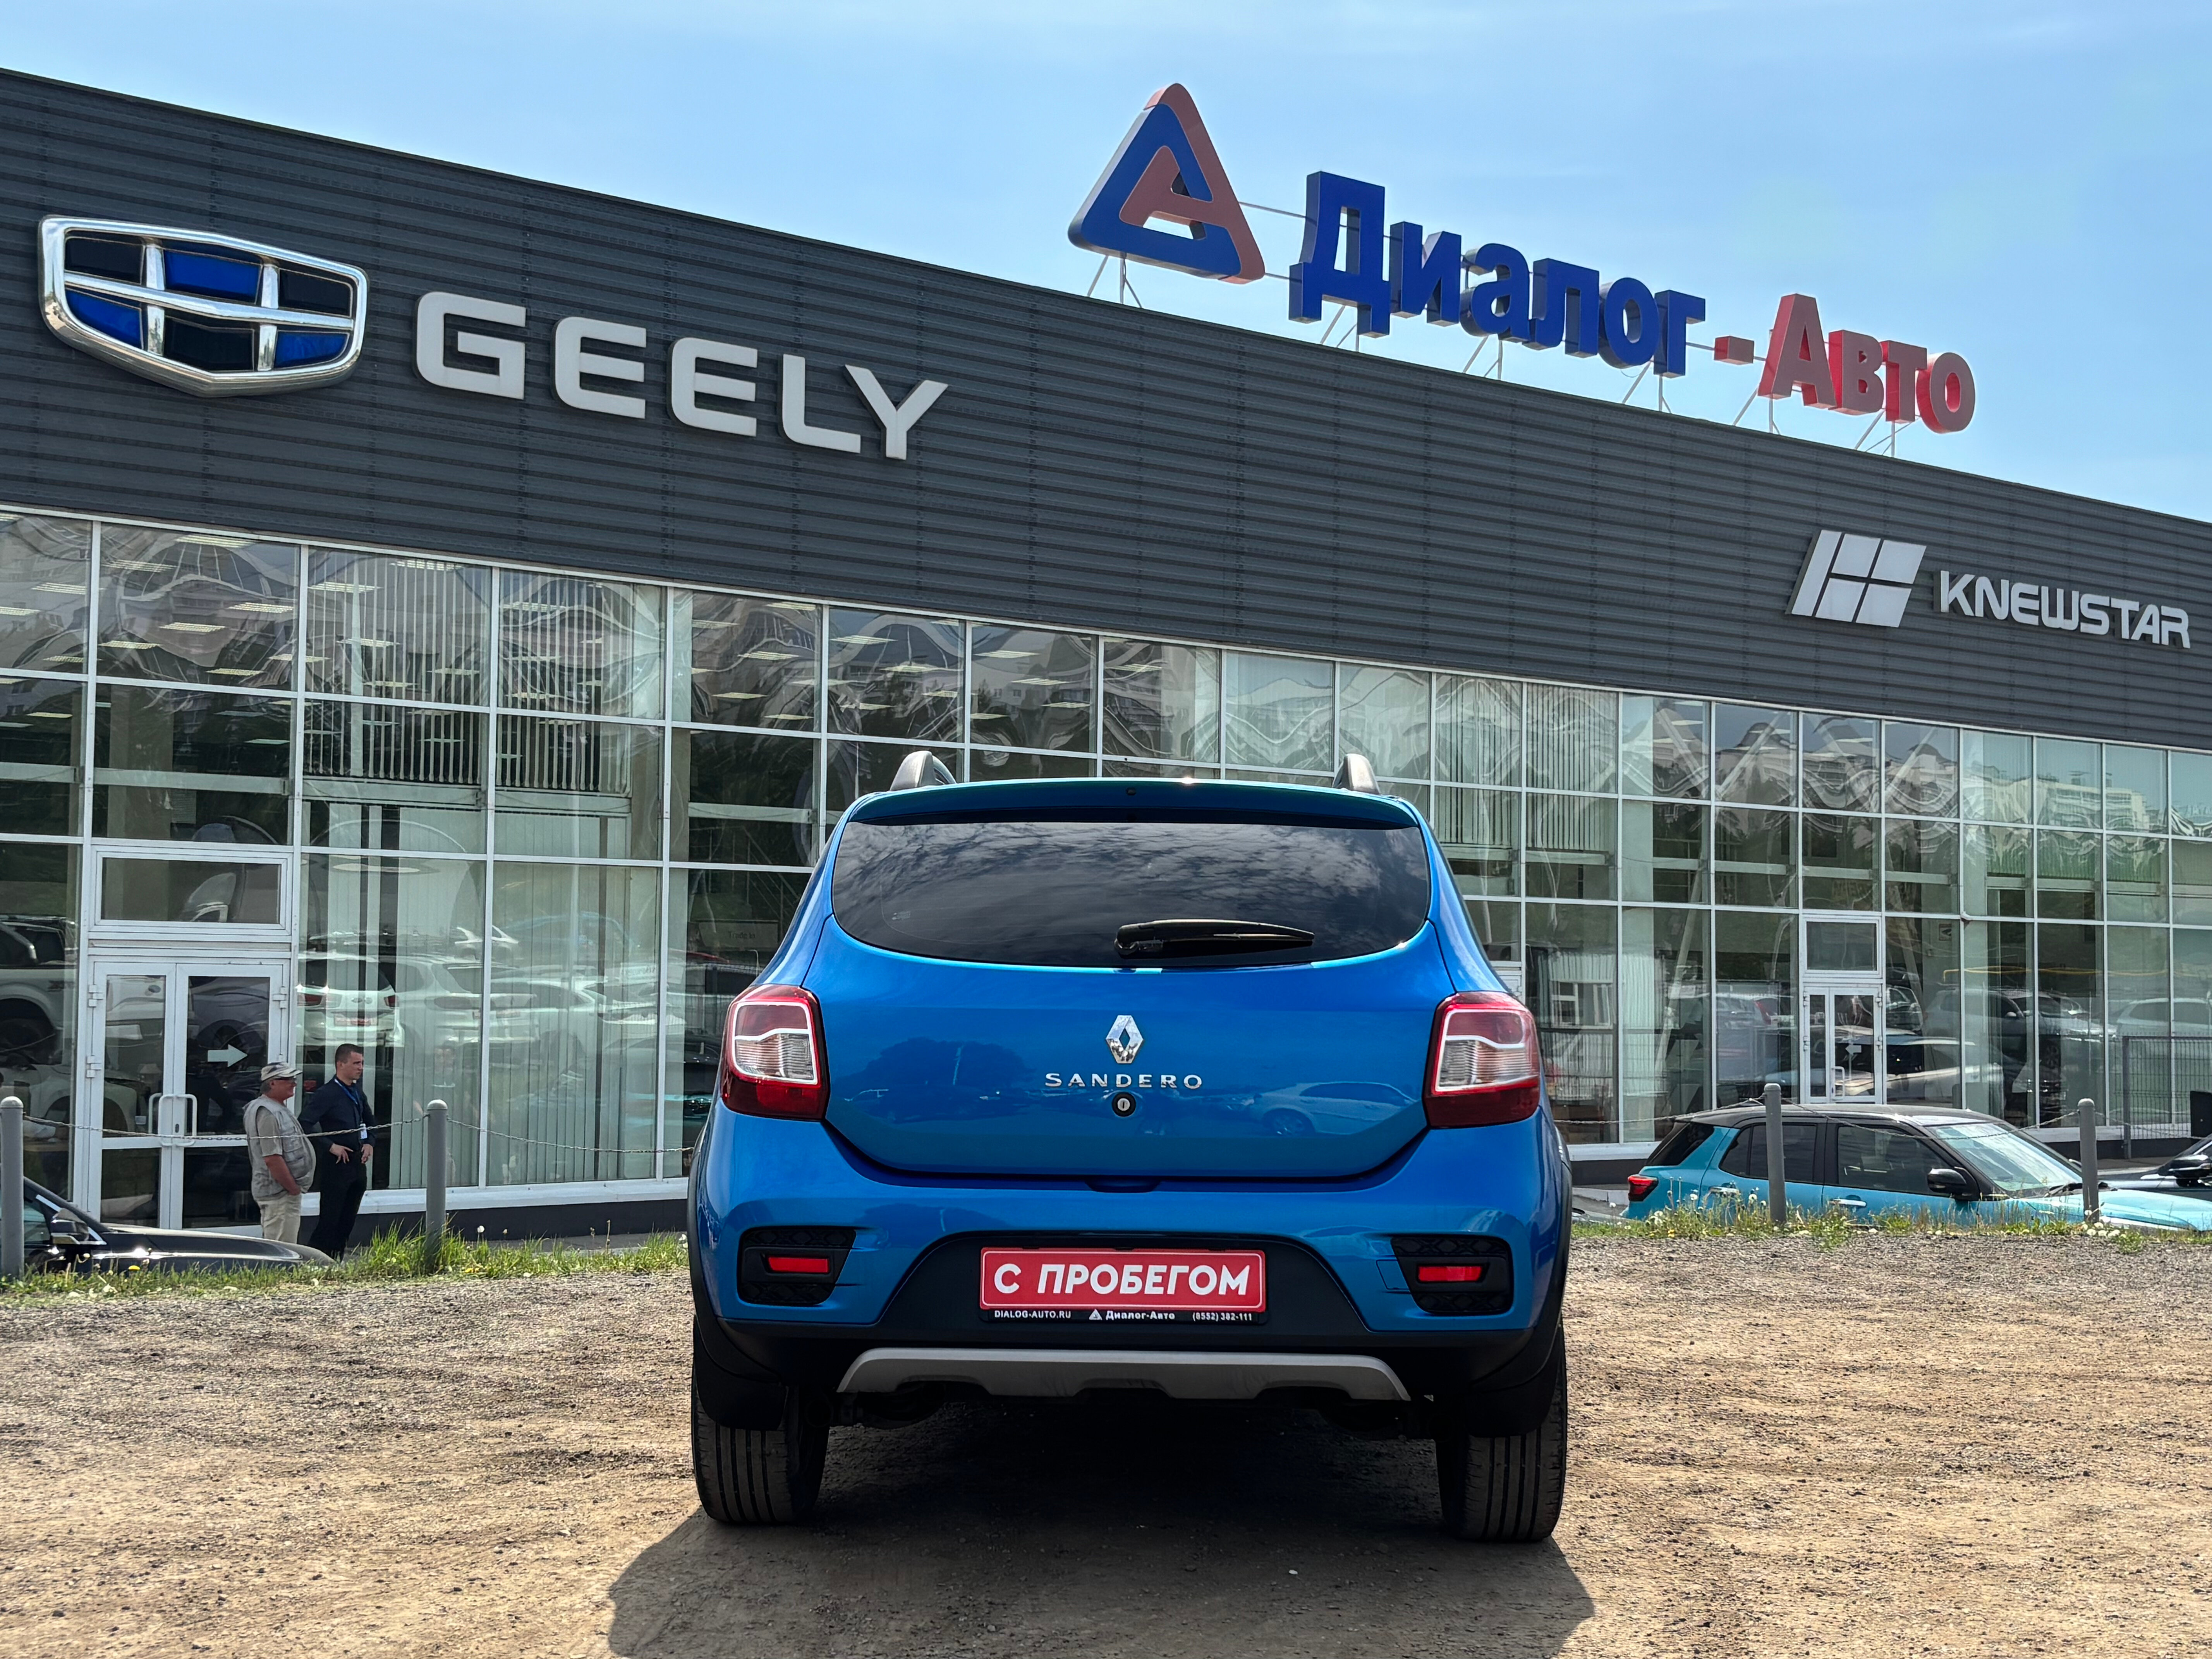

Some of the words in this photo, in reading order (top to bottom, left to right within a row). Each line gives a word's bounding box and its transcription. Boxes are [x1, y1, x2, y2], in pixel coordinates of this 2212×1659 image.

[1289, 170, 1976, 434] Диалог-Авто
[414, 291, 949, 460] GEELY
[1940, 570, 2191, 649] KNEWSTAR
[1045, 1073, 1202, 1089] SANDERO
[994, 1263, 1022, 1294] С
[1037, 1264, 1250, 1296] ПРОБЕГОМ
[994, 1310, 1071, 1319] DIALOG-AUTO.RU
[1105, 1310, 1175, 1321] Диалог-Авто
[1192, 1312, 1219, 1322] (8552)
[1220, 1312, 1252, 1321] 382-111
